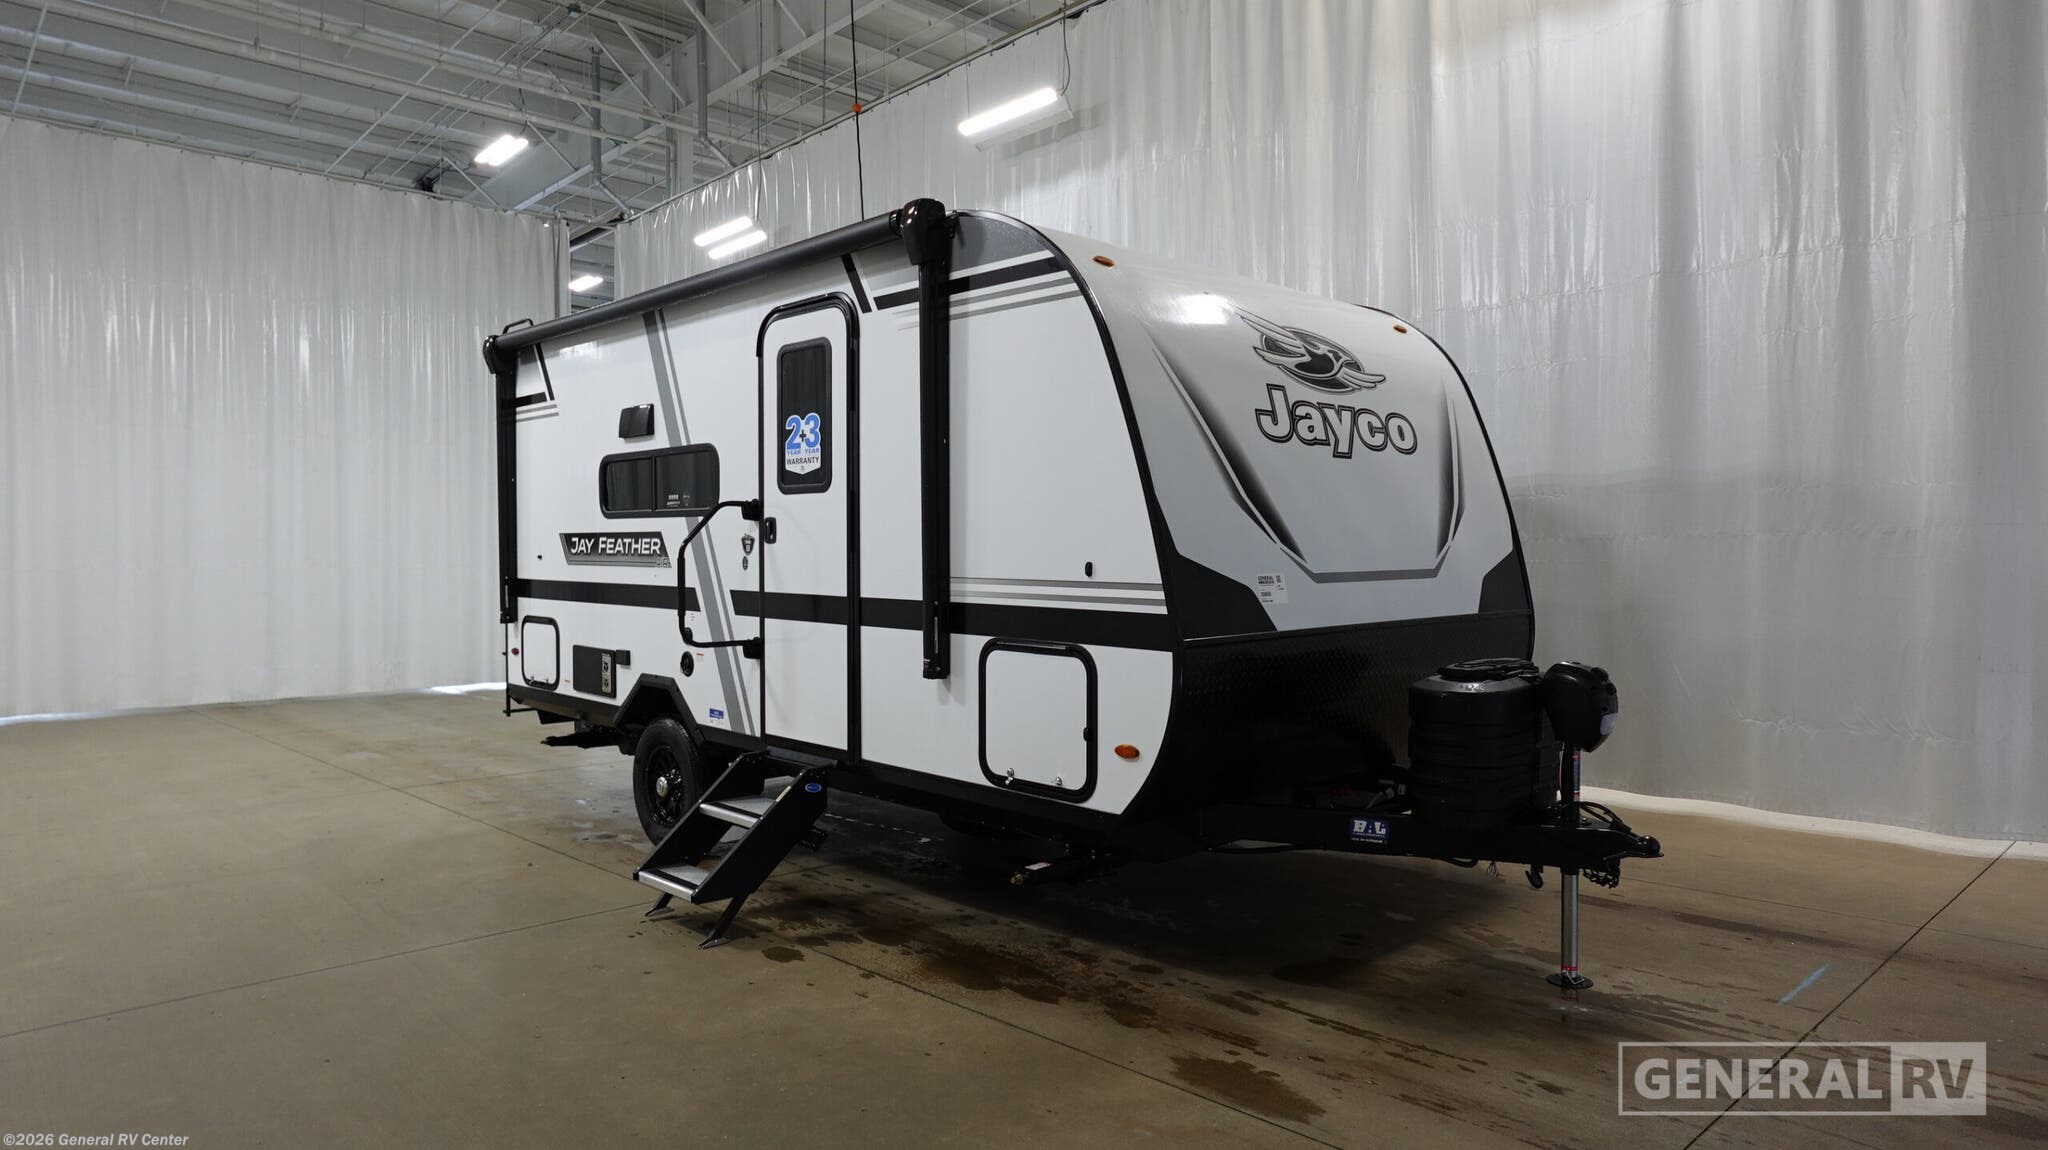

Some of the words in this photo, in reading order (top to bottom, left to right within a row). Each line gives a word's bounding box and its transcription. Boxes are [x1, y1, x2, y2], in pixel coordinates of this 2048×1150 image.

[1255, 383, 1418, 459] Jayco
[787, 456, 819, 465] WARRANTY
[571, 537, 595, 554] JAY
[598, 537, 661, 554] FEATHER
